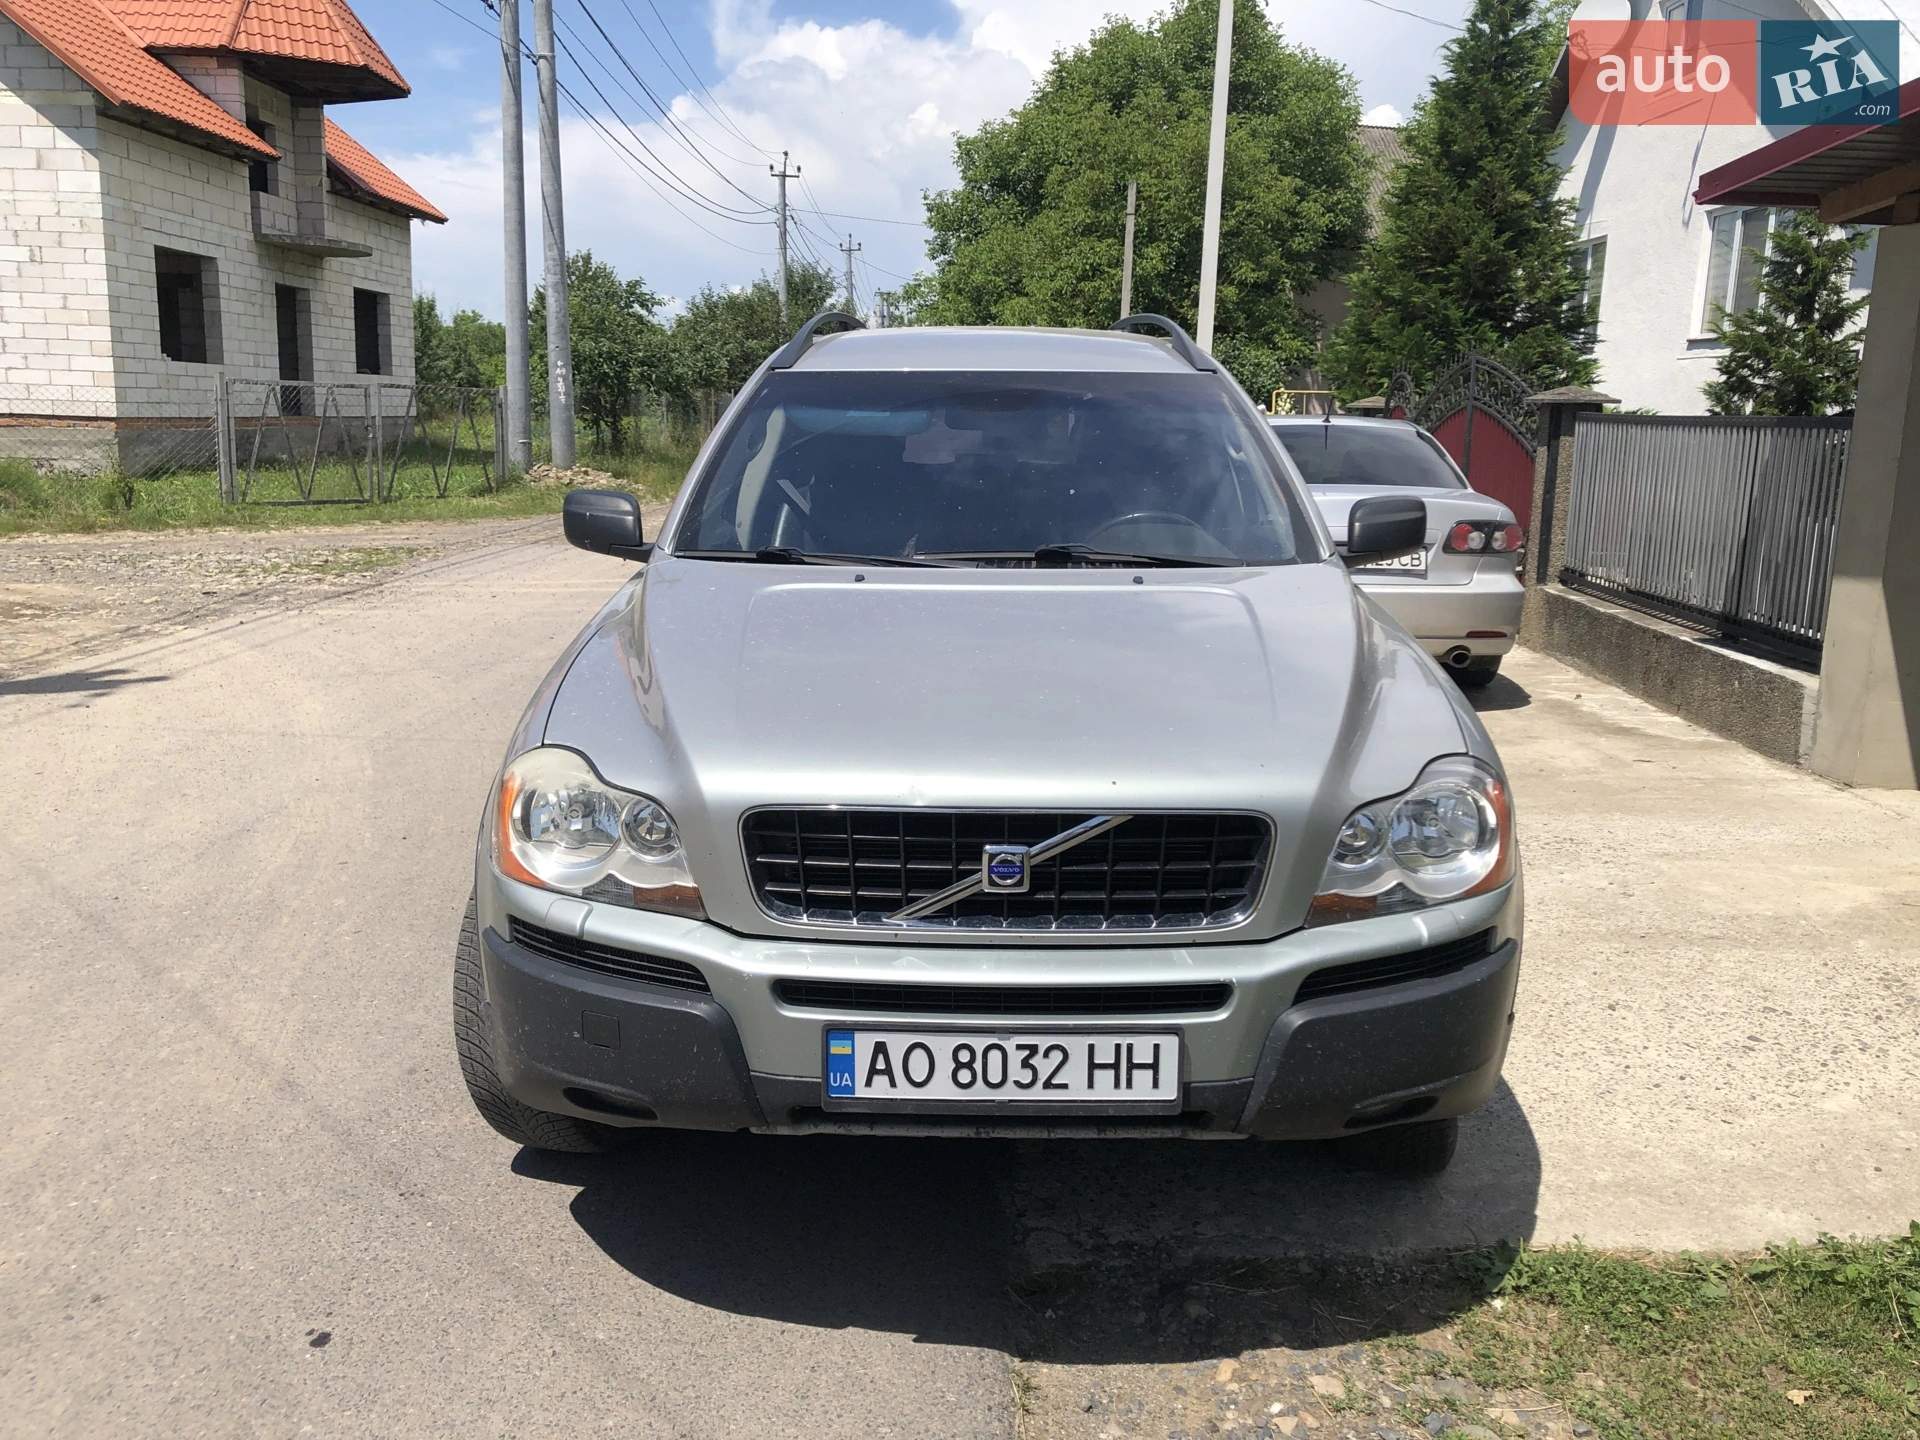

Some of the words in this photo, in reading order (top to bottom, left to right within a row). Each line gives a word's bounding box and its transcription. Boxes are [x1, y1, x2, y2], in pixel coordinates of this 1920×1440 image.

[830, 1073, 852, 1087] UA
[864, 1041, 936, 1090] AO
[951, 1043, 1070, 1090] 8032
[1087, 1043, 1160, 1090] HH
